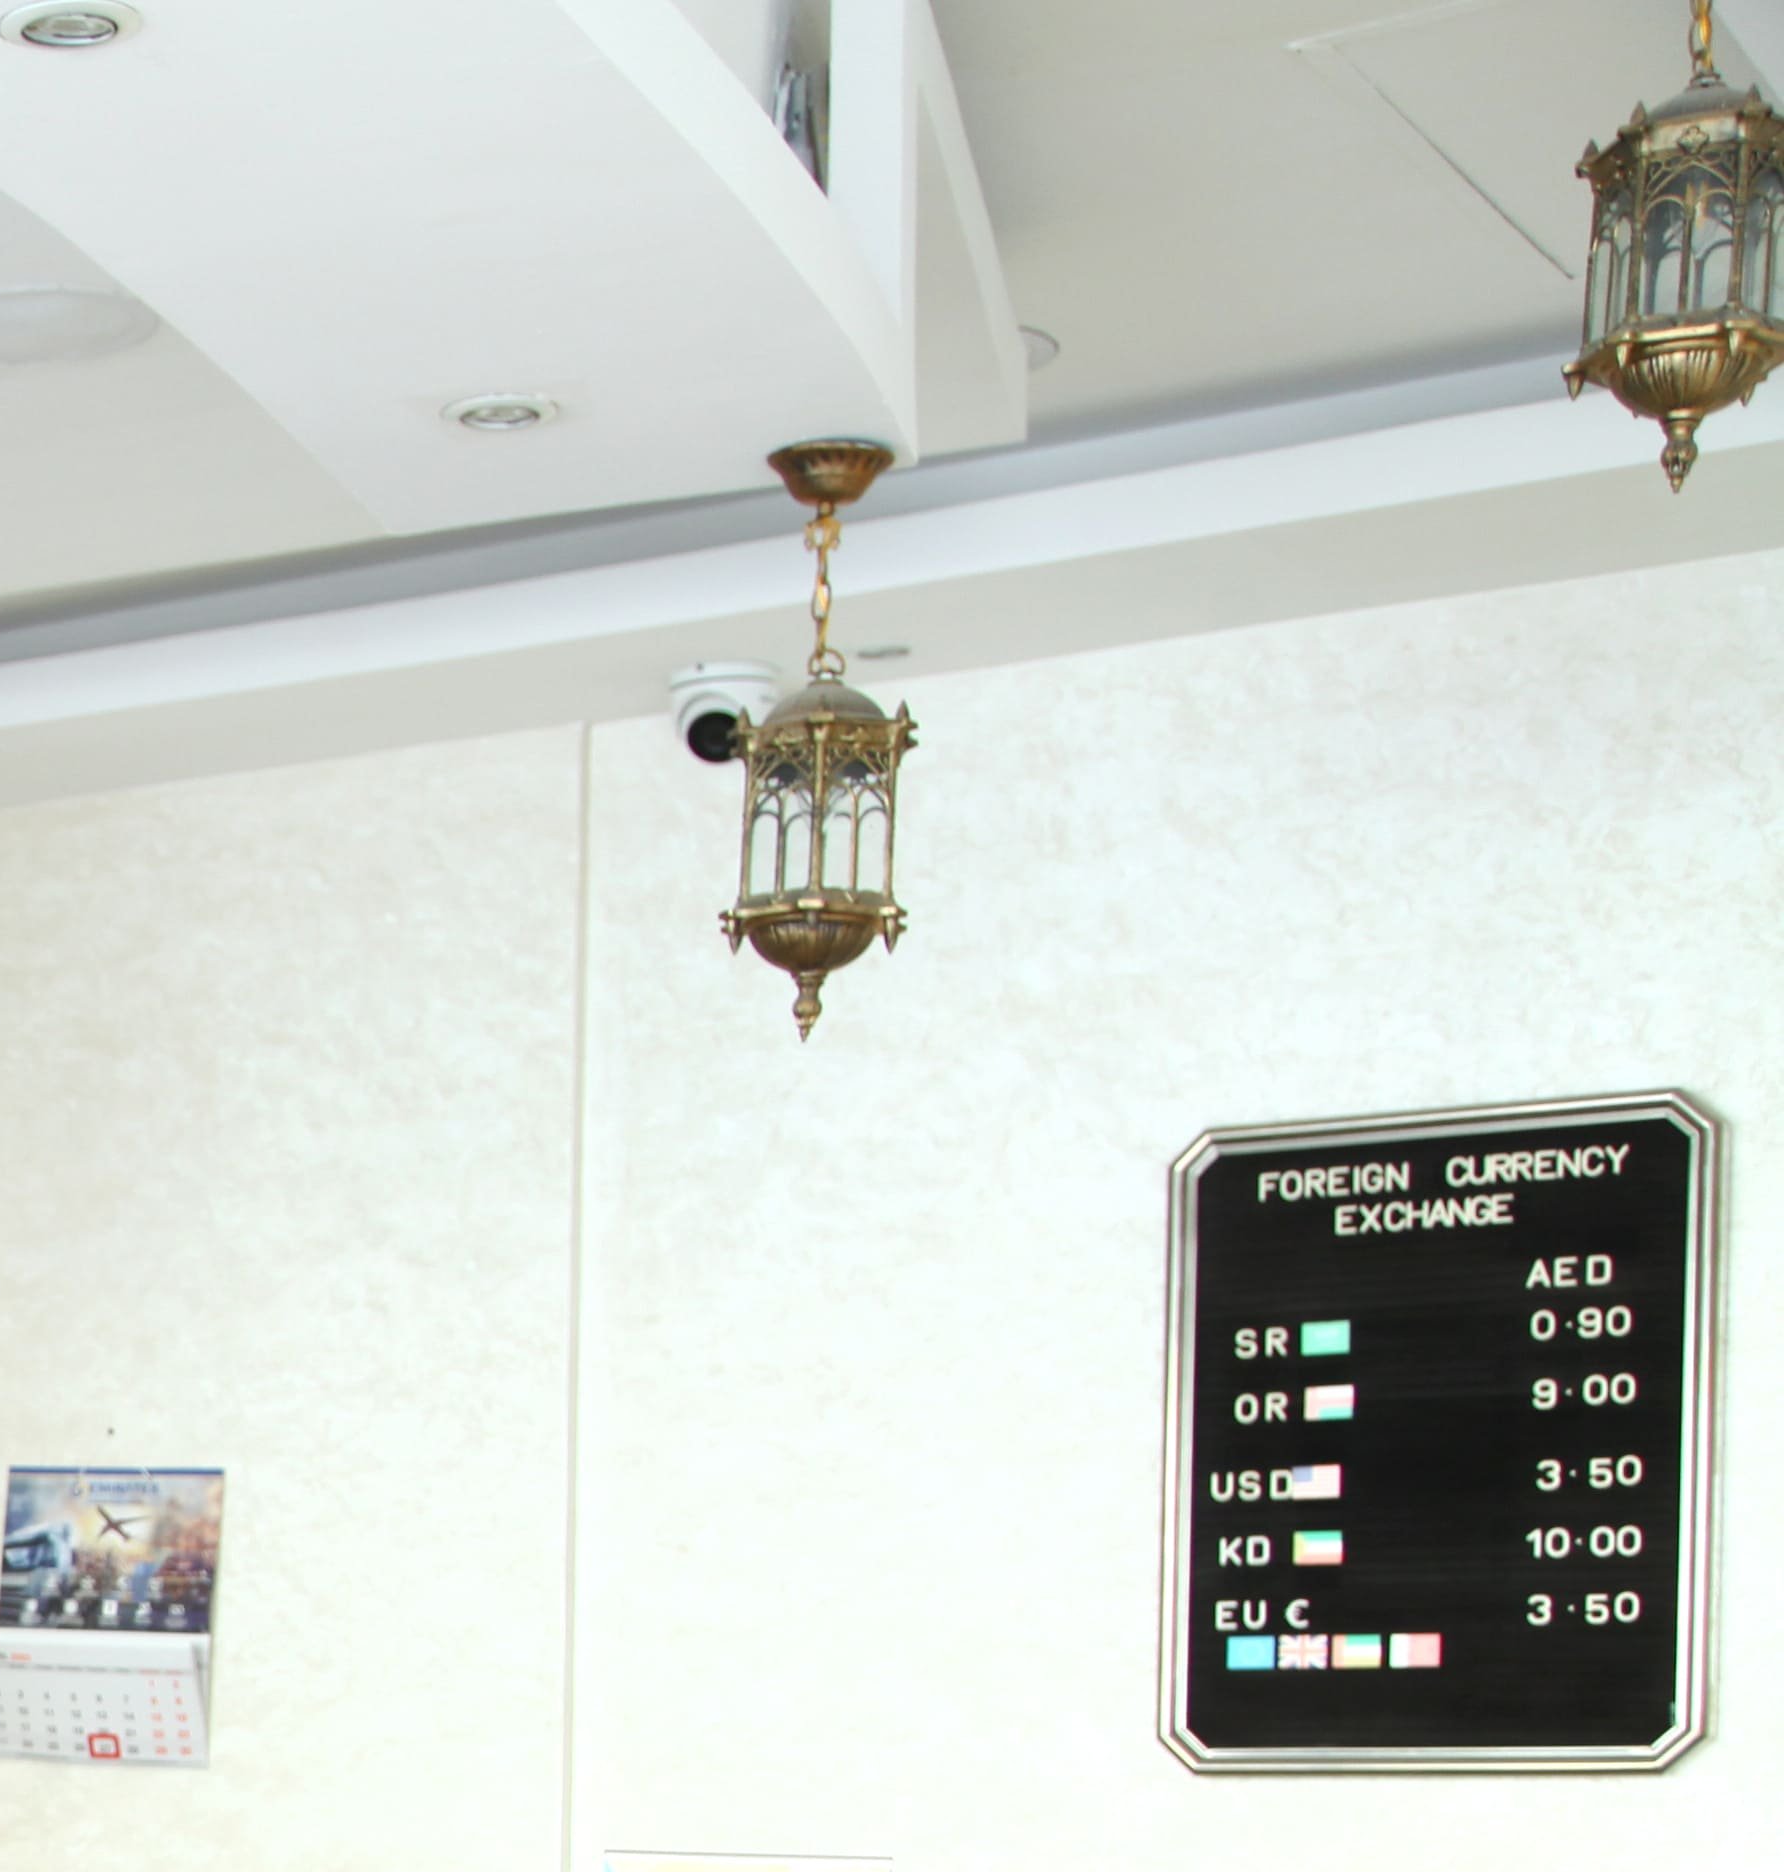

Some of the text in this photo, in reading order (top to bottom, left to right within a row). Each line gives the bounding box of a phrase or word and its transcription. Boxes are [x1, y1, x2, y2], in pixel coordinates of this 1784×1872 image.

[1258, 1143, 1630, 1203] FOREIGN CURRENCY
[1334, 1193, 1514, 1235] EXCHANGE
[1525, 1254, 1613, 1289] AED
[1235, 1327, 1289, 1359] SR
[1234, 1391, 1289, 1424] OR
[1210, 1469, 1292, 1502] USD
[1218, 1535, 1271, 1566] KD
[1216, 1600, 1267, 1630] EU
